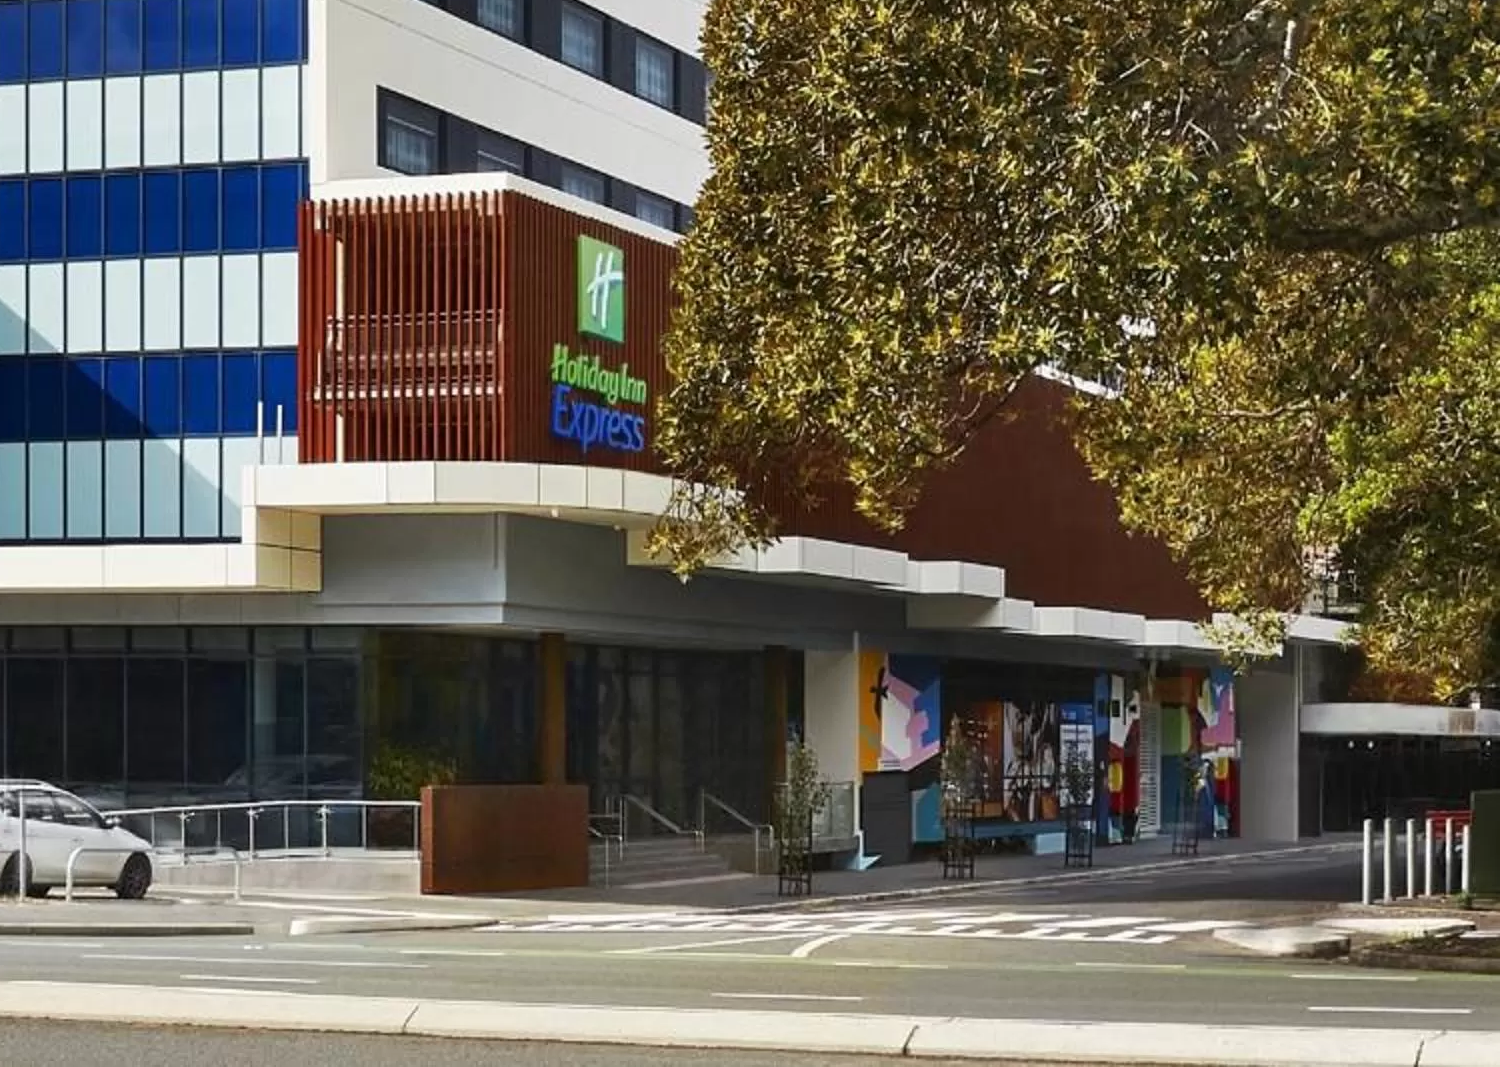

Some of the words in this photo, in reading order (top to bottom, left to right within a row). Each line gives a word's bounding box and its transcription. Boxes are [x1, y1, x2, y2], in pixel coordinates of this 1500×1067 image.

[551, 343, 620, 405] Holiday
[620, 363, 647, 405] Inn
[553, 384, 645, 454] Express
